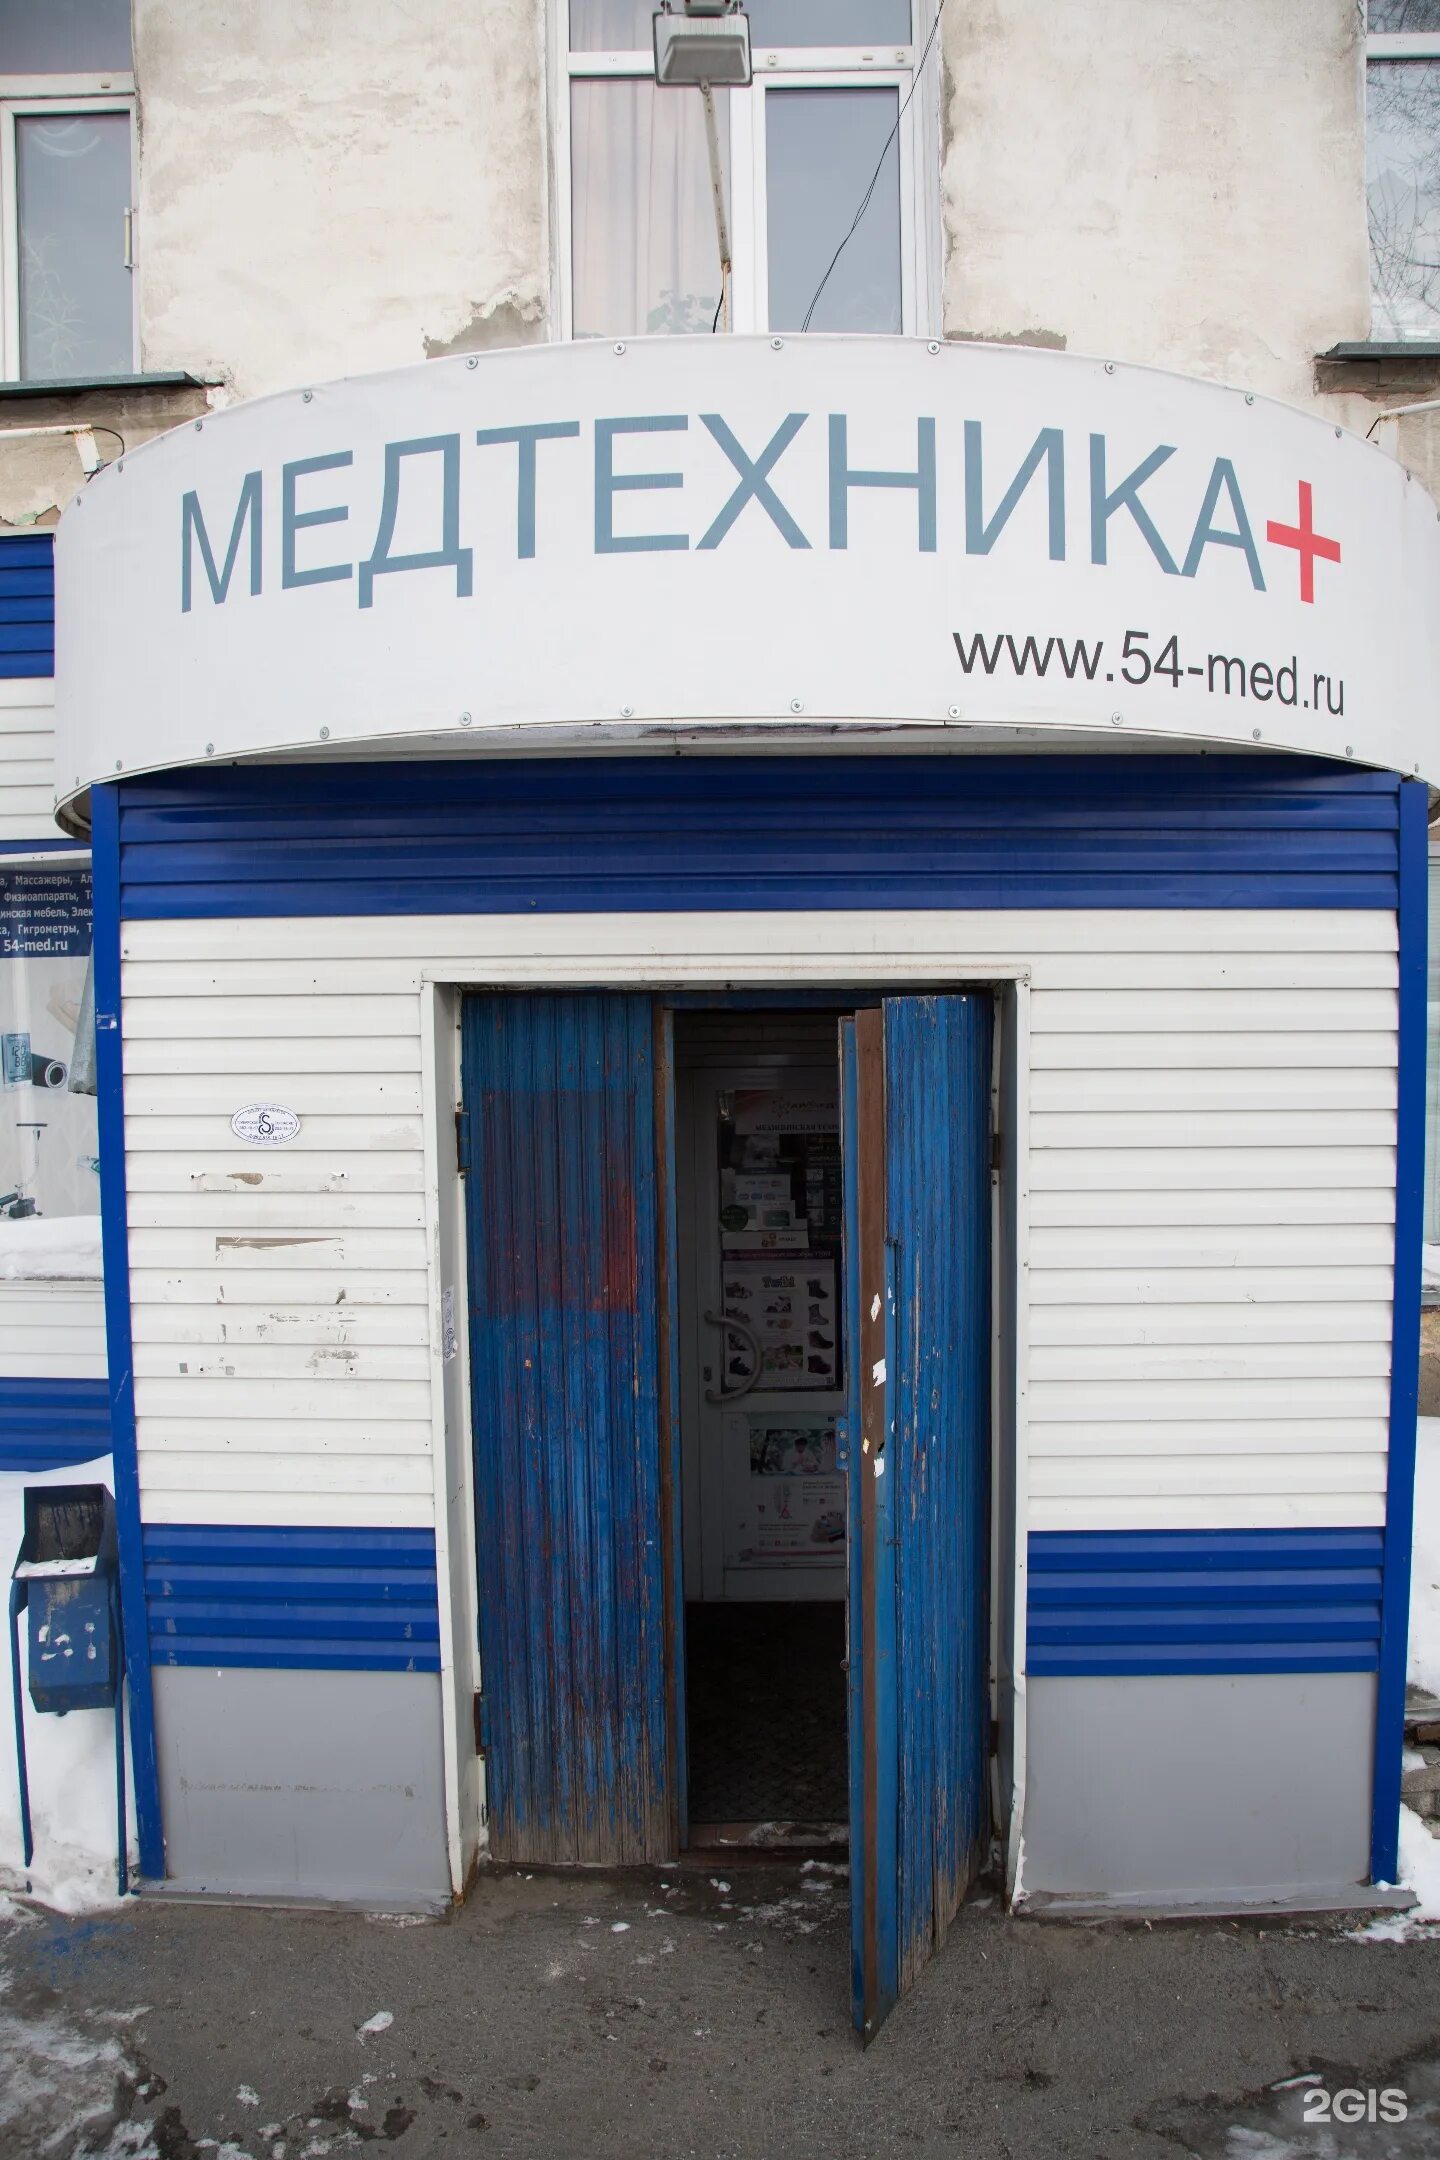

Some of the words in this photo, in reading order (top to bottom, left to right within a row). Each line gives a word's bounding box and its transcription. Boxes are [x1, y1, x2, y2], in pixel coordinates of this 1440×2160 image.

[952, 630, 1345, 716] www.54-med.ru
[15, 875, 73, 887] Массажеры,
[4, 892, 79, 903] Физиоаппараты,
[34, 906, 70, 919] мебель,
[17, 924, 80, 936] Гигрометры,
[4, 937, 69, 952] 54-med.ru
